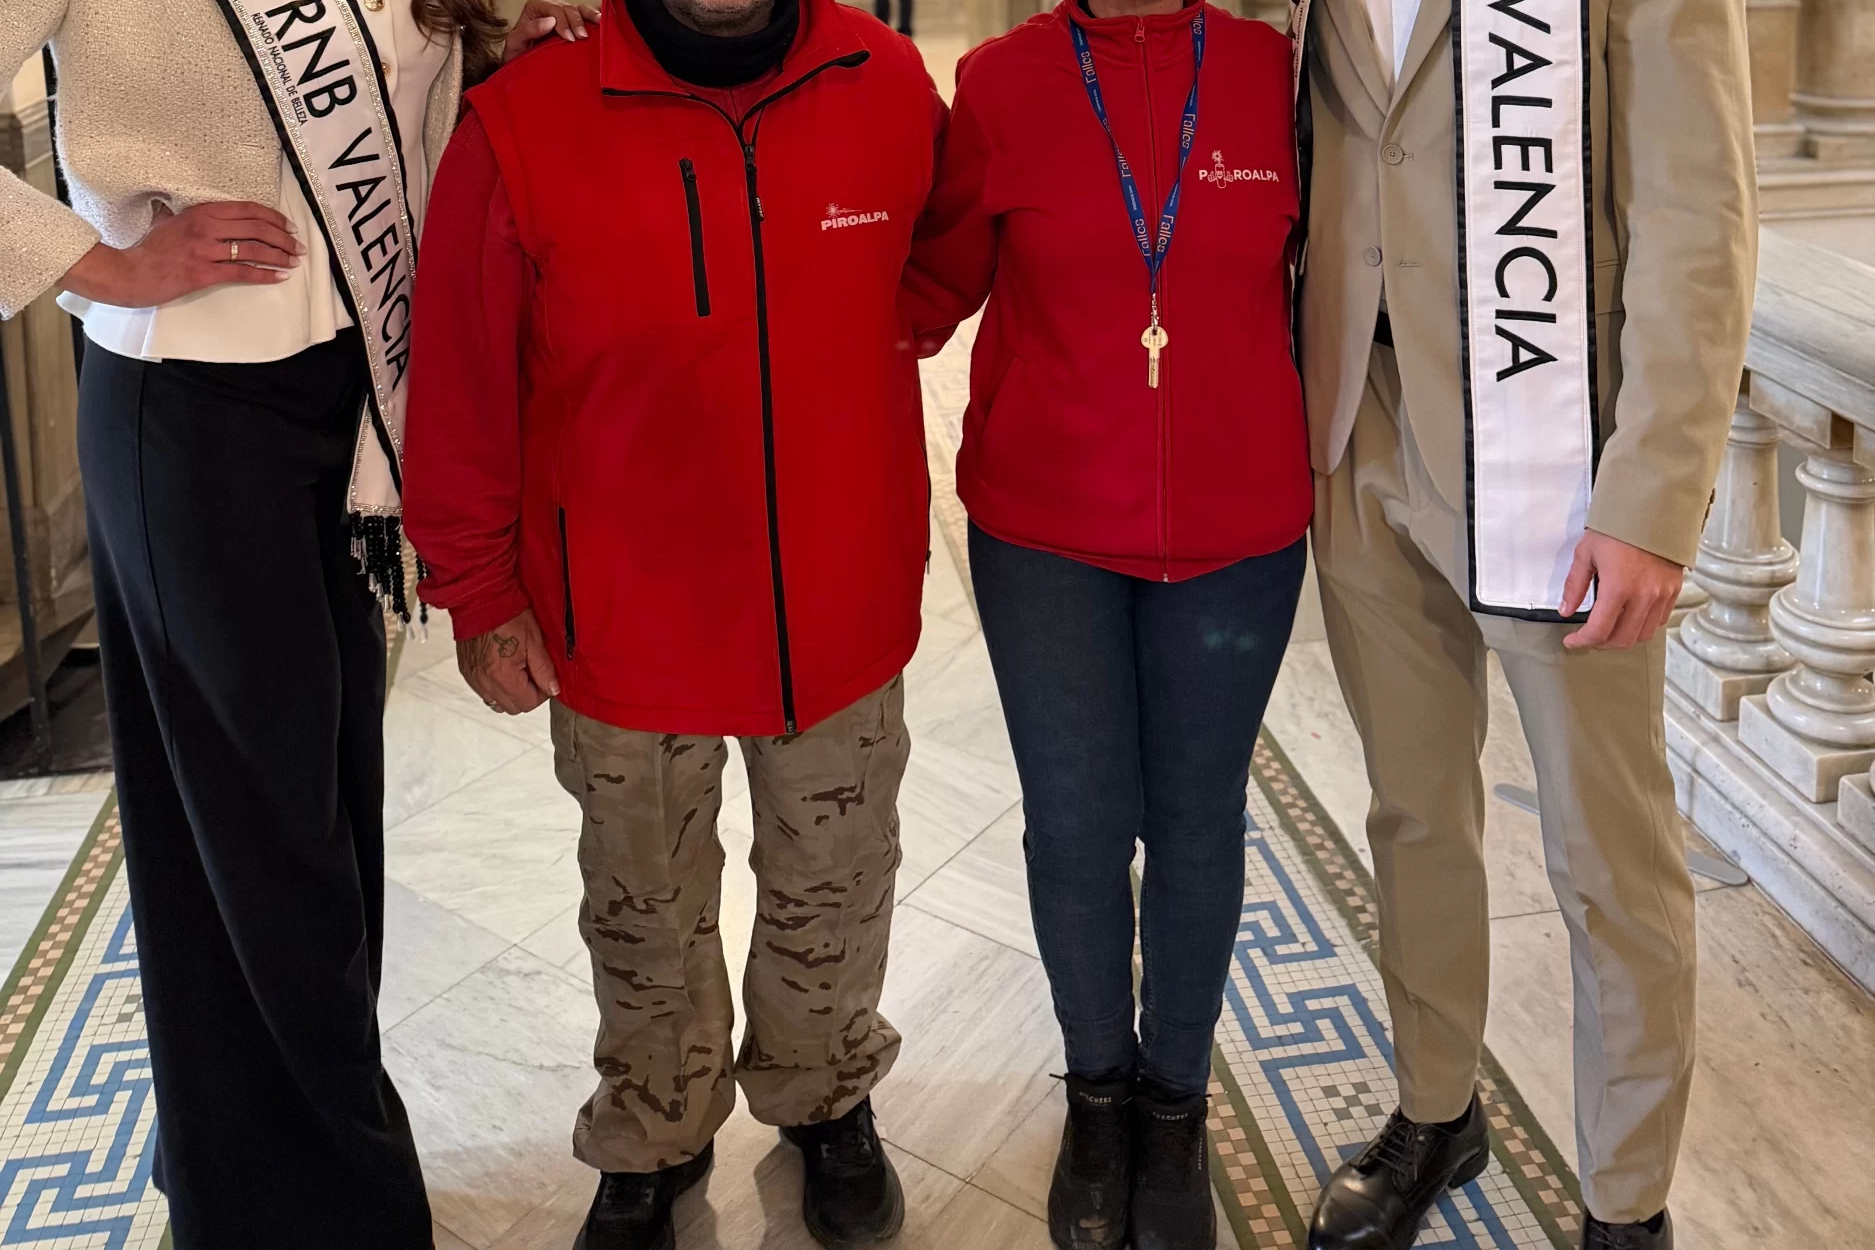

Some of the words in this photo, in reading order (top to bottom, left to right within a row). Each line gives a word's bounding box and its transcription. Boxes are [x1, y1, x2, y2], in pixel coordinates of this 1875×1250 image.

[251, 12, 274, 45] REINADO
[268, 45, 292, 86] NACIONAL
[286, 85, 298, 97] DE
[291, 96, 308, 127] BELLEZA
[820, 211, 889, 230] PIROALPA
[328, 126, 412, 391] VALENCIA
